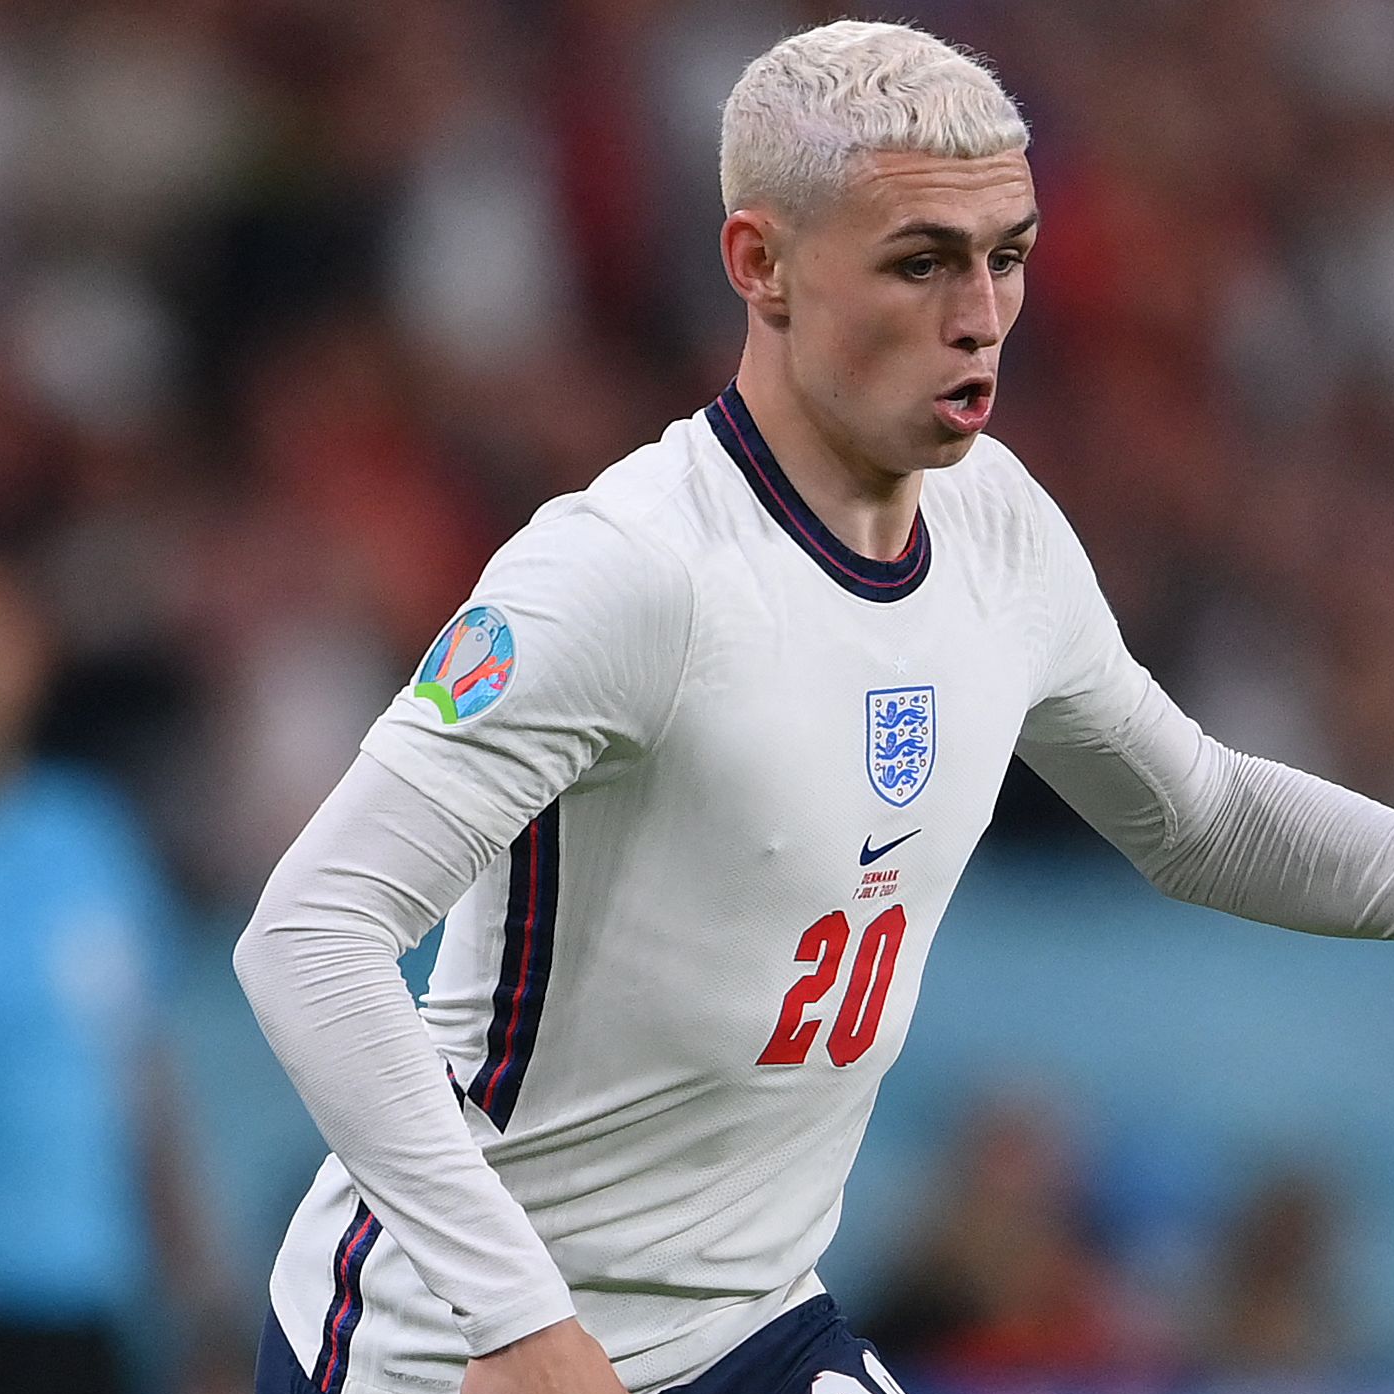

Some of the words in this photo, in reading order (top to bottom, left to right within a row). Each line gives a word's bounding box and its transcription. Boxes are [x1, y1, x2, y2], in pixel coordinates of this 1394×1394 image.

[861, 869, 899, 884] DENMARK
[858, 886, 878, 899] JULY
[755, 904, 907, 1067] 20
